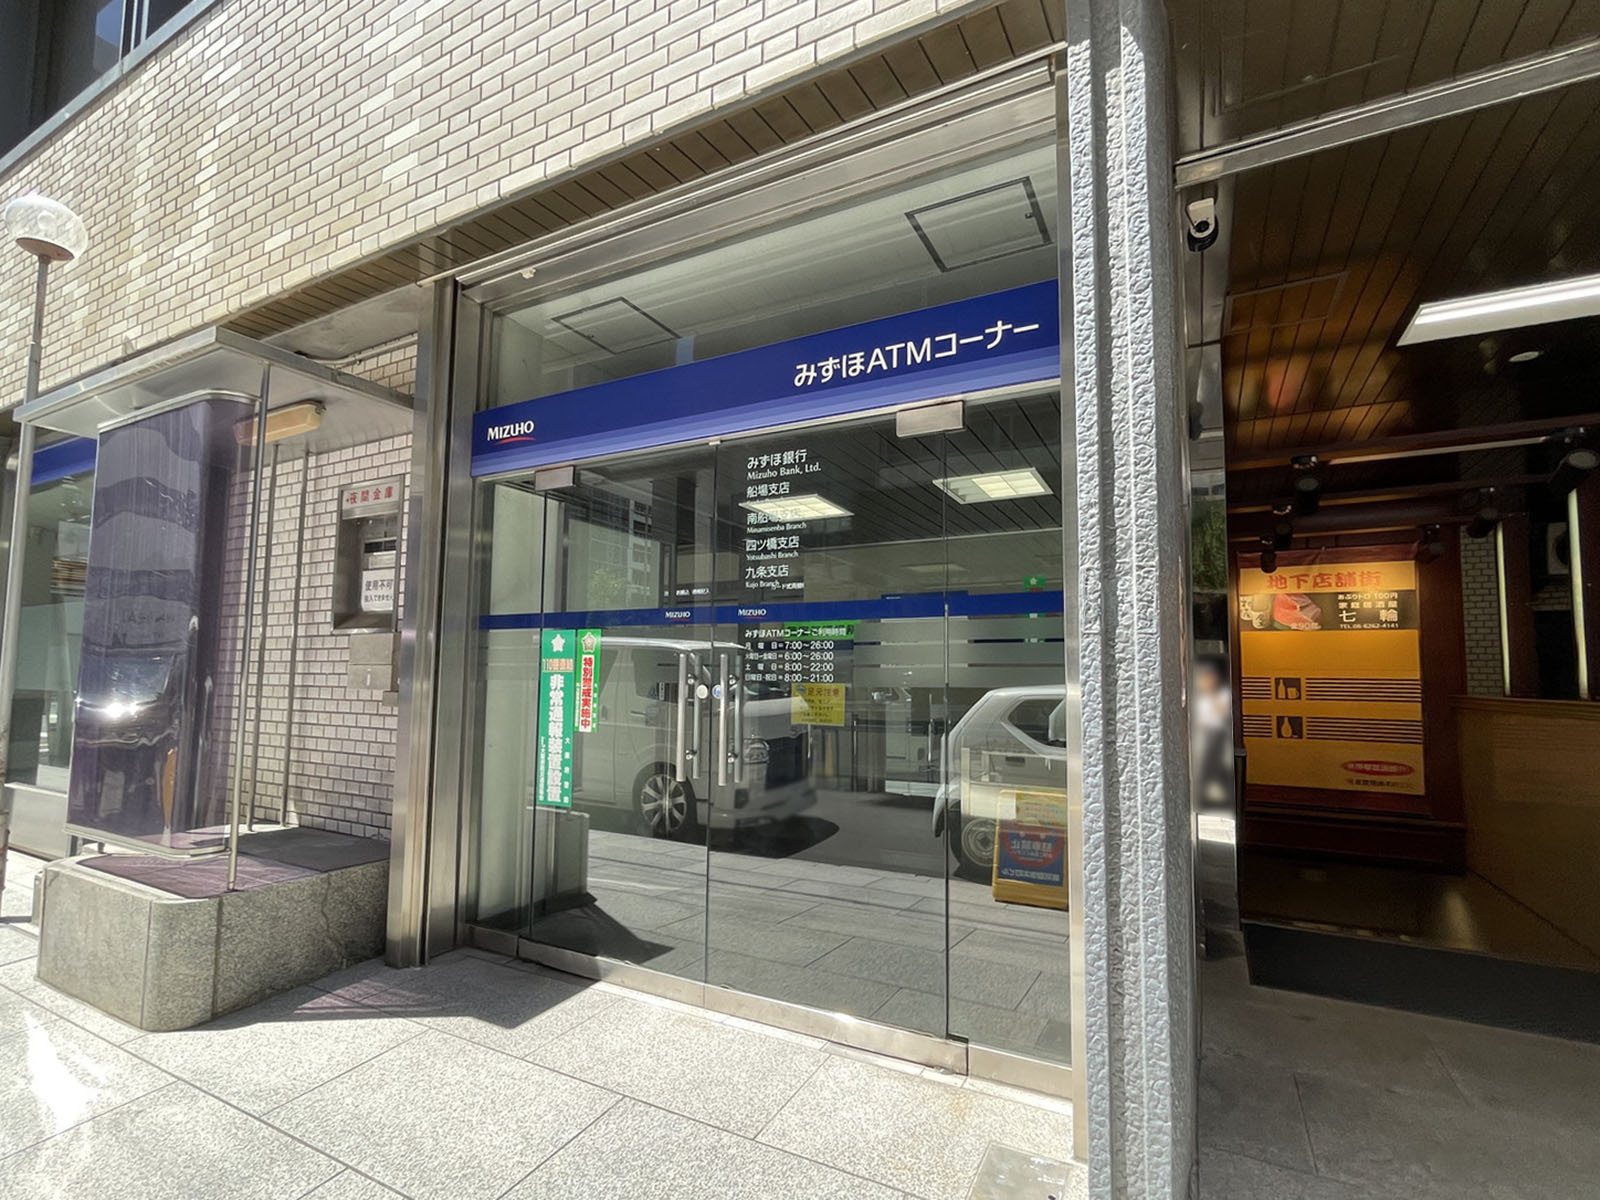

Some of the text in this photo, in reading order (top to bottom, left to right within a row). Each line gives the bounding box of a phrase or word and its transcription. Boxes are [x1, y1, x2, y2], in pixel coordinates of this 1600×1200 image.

[793, 321, 1040, 387] みずほATMコーナー
[487, 420, 535, 441] MIZUHO
[747, 449, 807, 469] みずほ銀行
[747, 462, 822, 480] Mizuho Bank, Ltd.
[350, 486, 393, 505] 夜間金庫
[746, 481, 790, 498] 船場支店
[745, 536, 800, 551] 四ツ橋支店
[745, 565, 789, 579] 九条支店
[1267, 571, 1381, 590] 地下店舗街
[365, 580, 393, 591] 使用不可
[665, 611, 691, 619] MIZUHO
[738, 608, 767, 616] MIZUHO
[1338, 609, 1398, 622] 七輪
[581, 657, 593, 728] 特別警戒実施中
